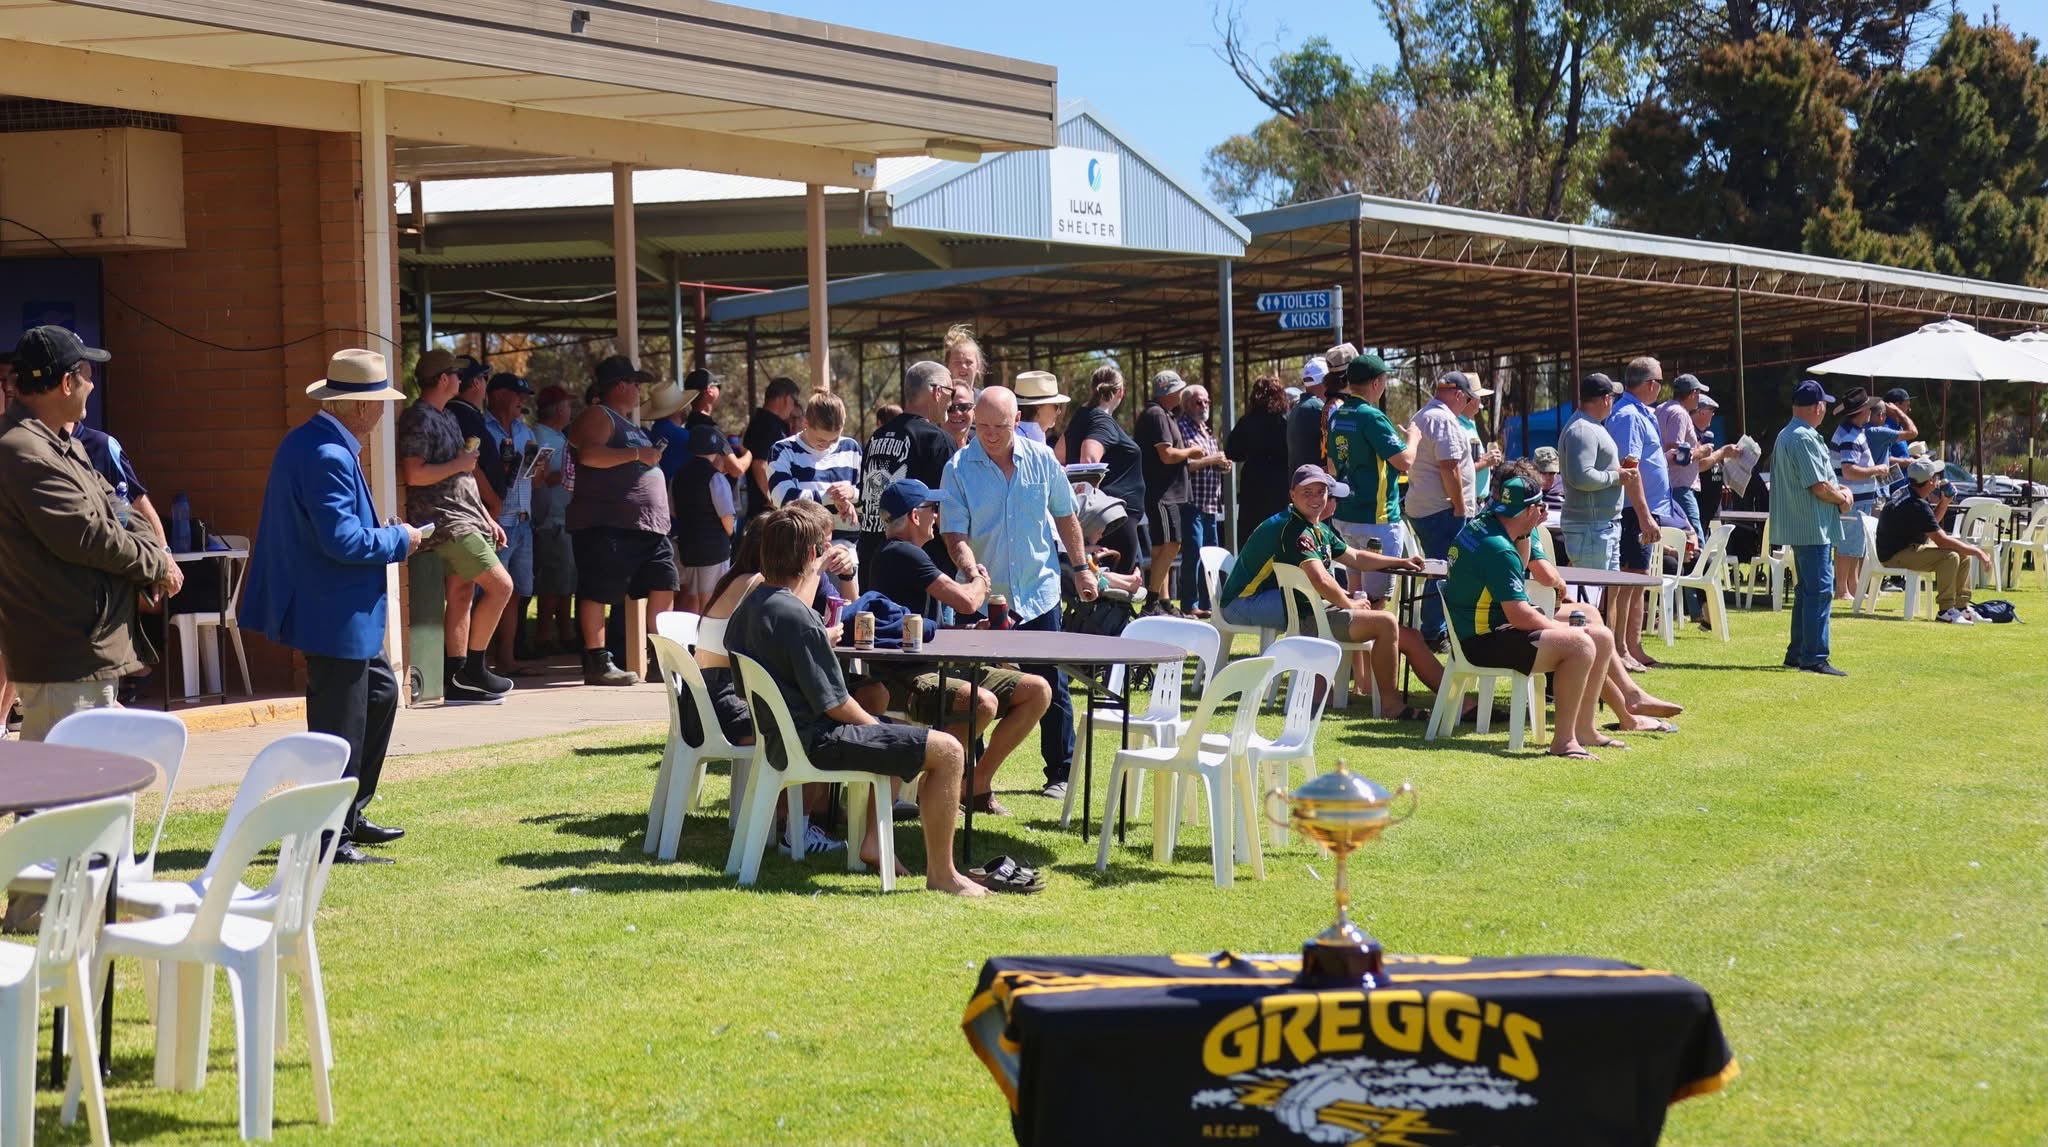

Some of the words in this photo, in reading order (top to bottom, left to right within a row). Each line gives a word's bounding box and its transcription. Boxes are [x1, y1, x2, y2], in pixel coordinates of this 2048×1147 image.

[1070, 199, 1103, 216] ILUKA
[1058, 218, 1115, 238] SHELTER
[1281, 293, 1327, 309] TOILETS
[1291, 311, 1326, 328] KIOSK
[1202, 989, 1543, 1081] GREGG'S
